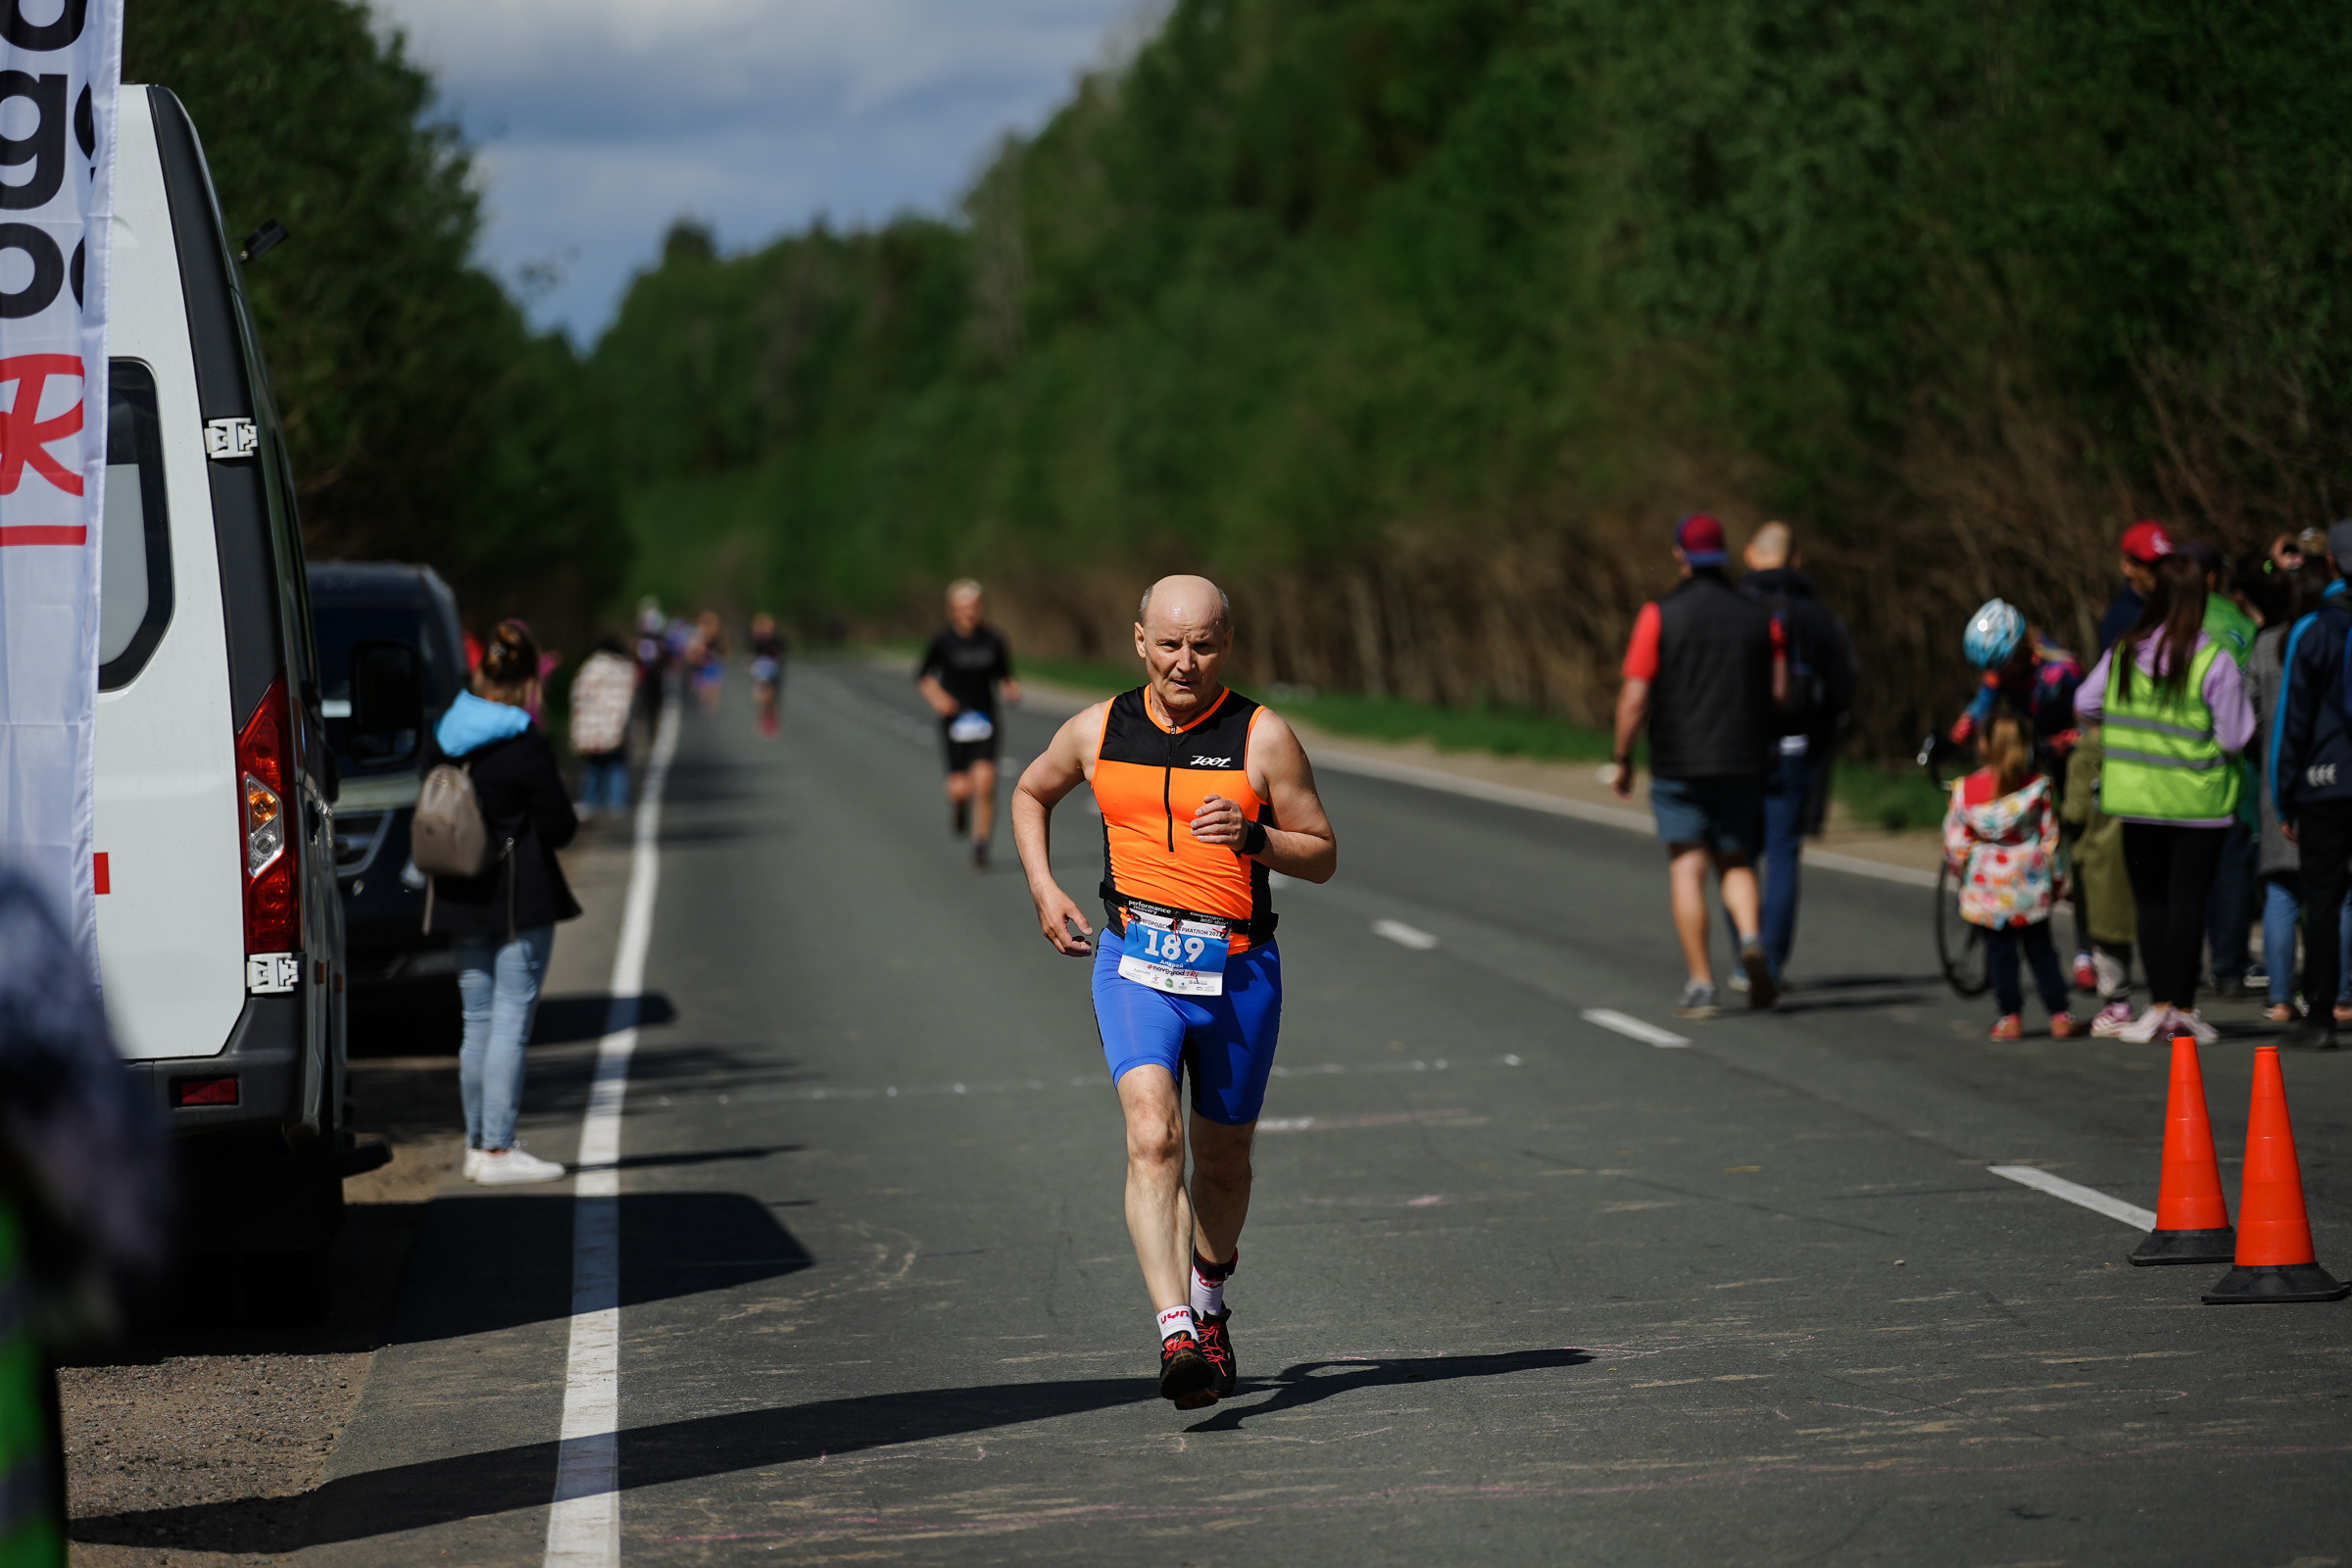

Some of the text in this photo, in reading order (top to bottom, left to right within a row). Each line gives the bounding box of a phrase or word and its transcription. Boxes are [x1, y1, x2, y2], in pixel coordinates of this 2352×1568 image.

[1128, 900, 1172, 914] performance
[1133, 906, 1157, 916] recovery
[1145, 929, 1205, 963] 189
[1159, 959, 1184, 968] Андрей
